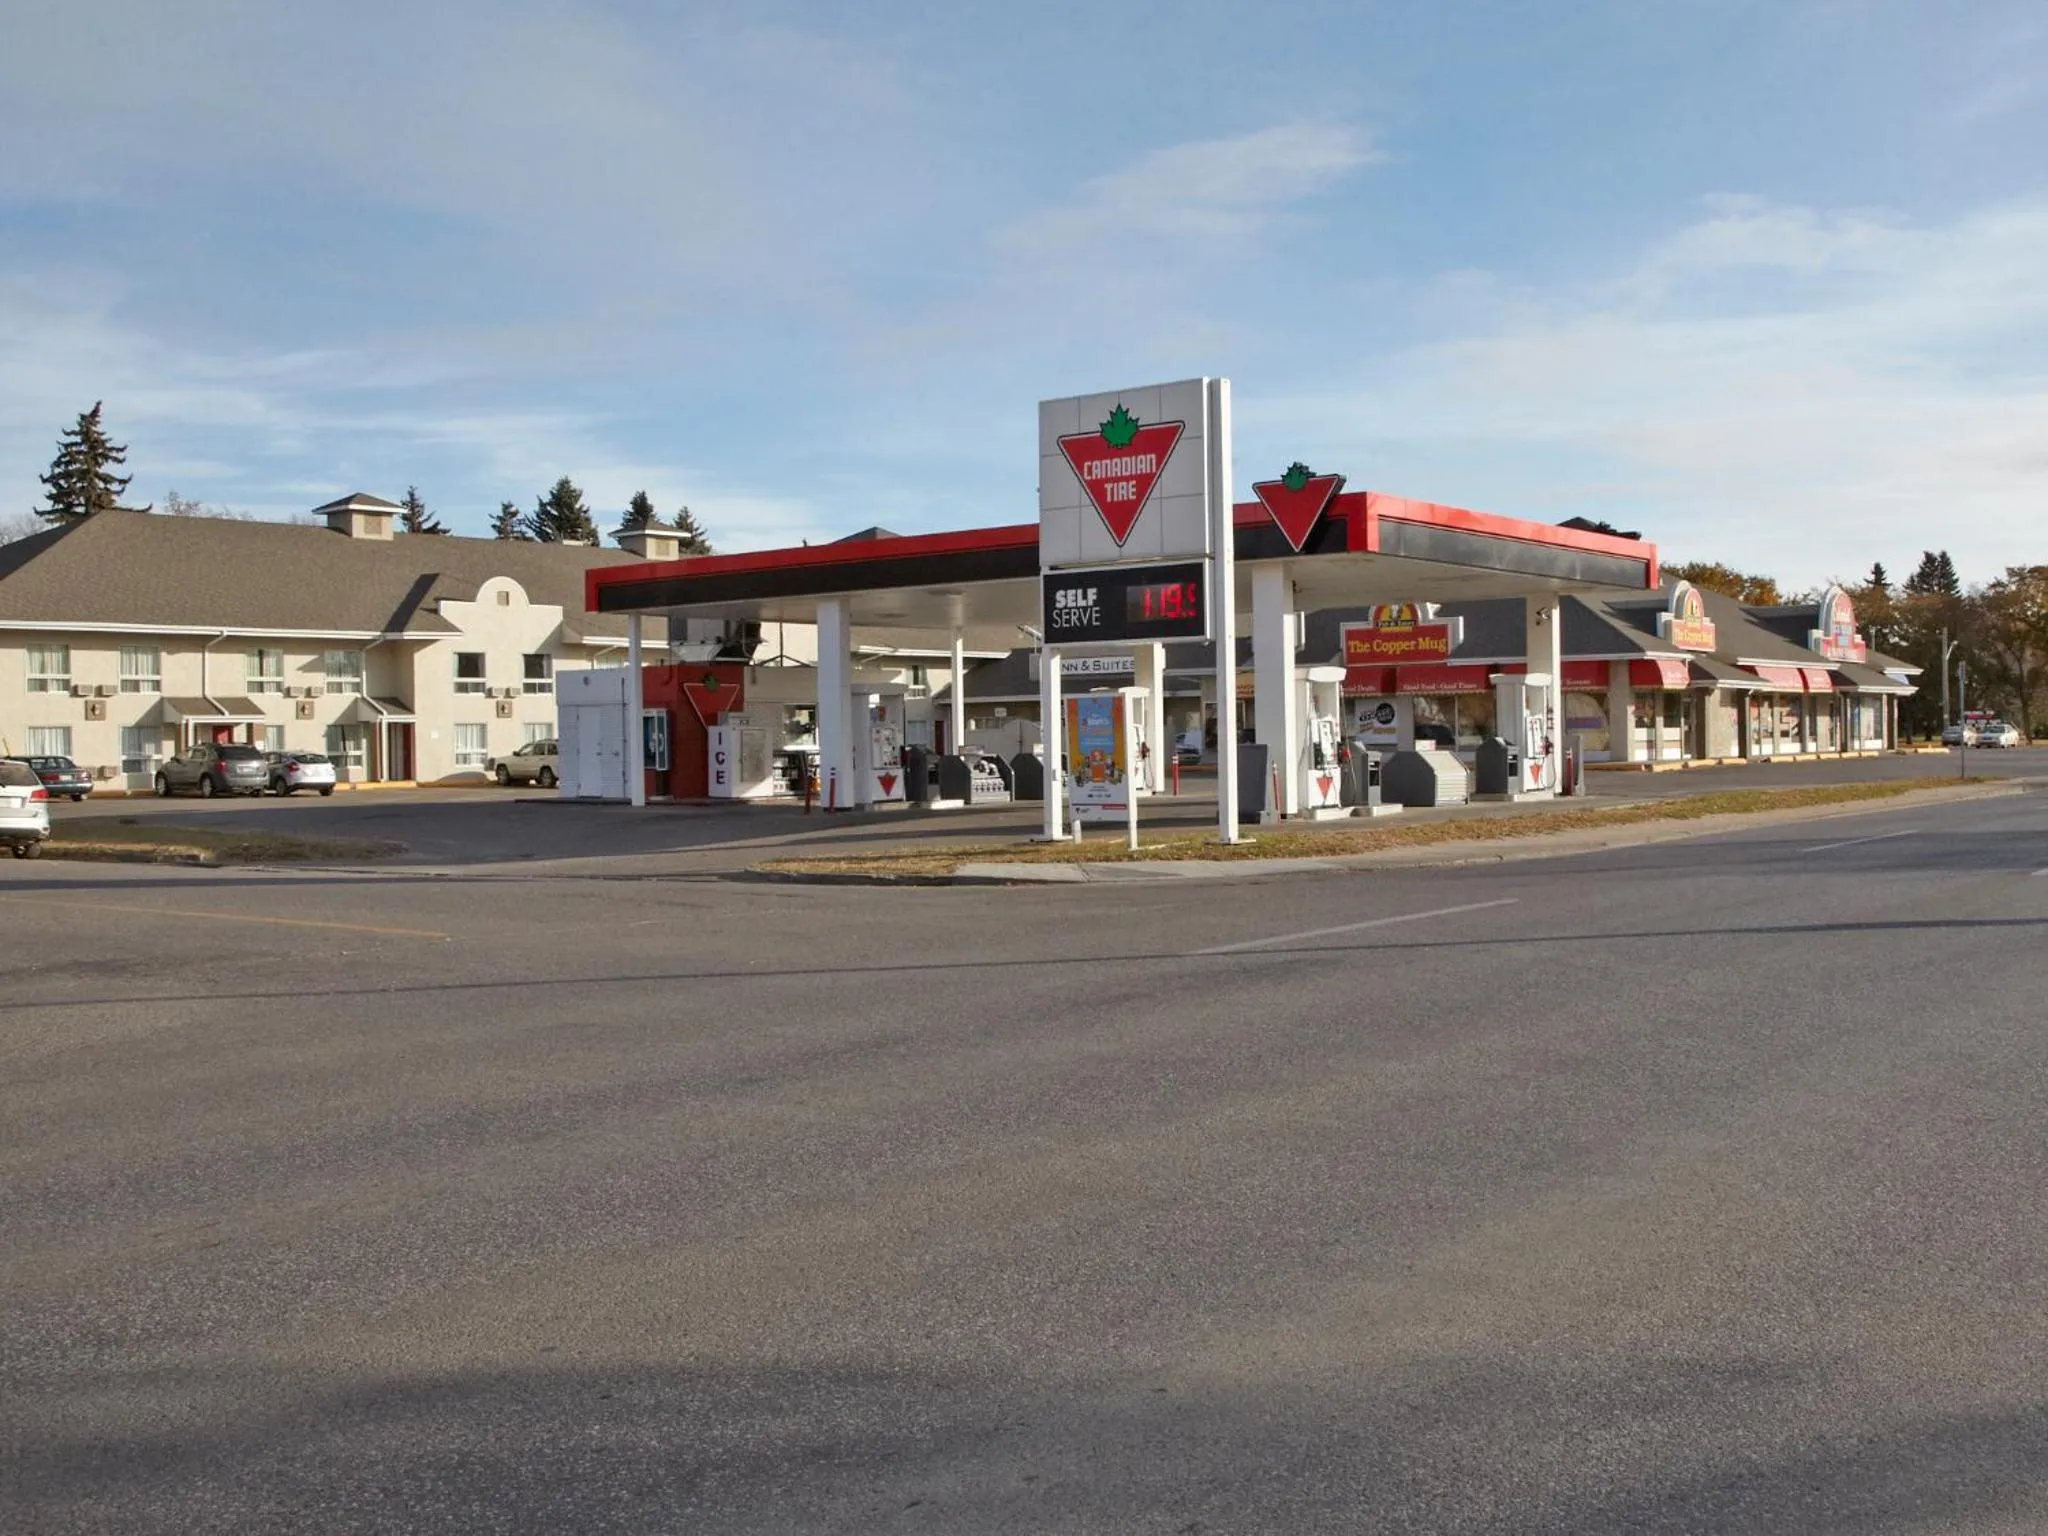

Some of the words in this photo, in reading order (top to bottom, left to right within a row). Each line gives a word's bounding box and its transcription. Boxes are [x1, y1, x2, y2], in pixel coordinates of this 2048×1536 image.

[1084, 454, 1156, 480] CANADIAN
[1104, 480, 1137, 503] TIRE
[1055, 587, 1098, 608] SELF
[1052, 606, 1101, 629] SERVE
[1348, 640, 1371, 653] The
[1372, 638, 1417, 655] Copper
[1417, 636, 1447, 653] Mug
[1061, 663, 1078, 672] NN
[1081, 660, 1089, 671] &
[715, 731, 726, 785] ICE
